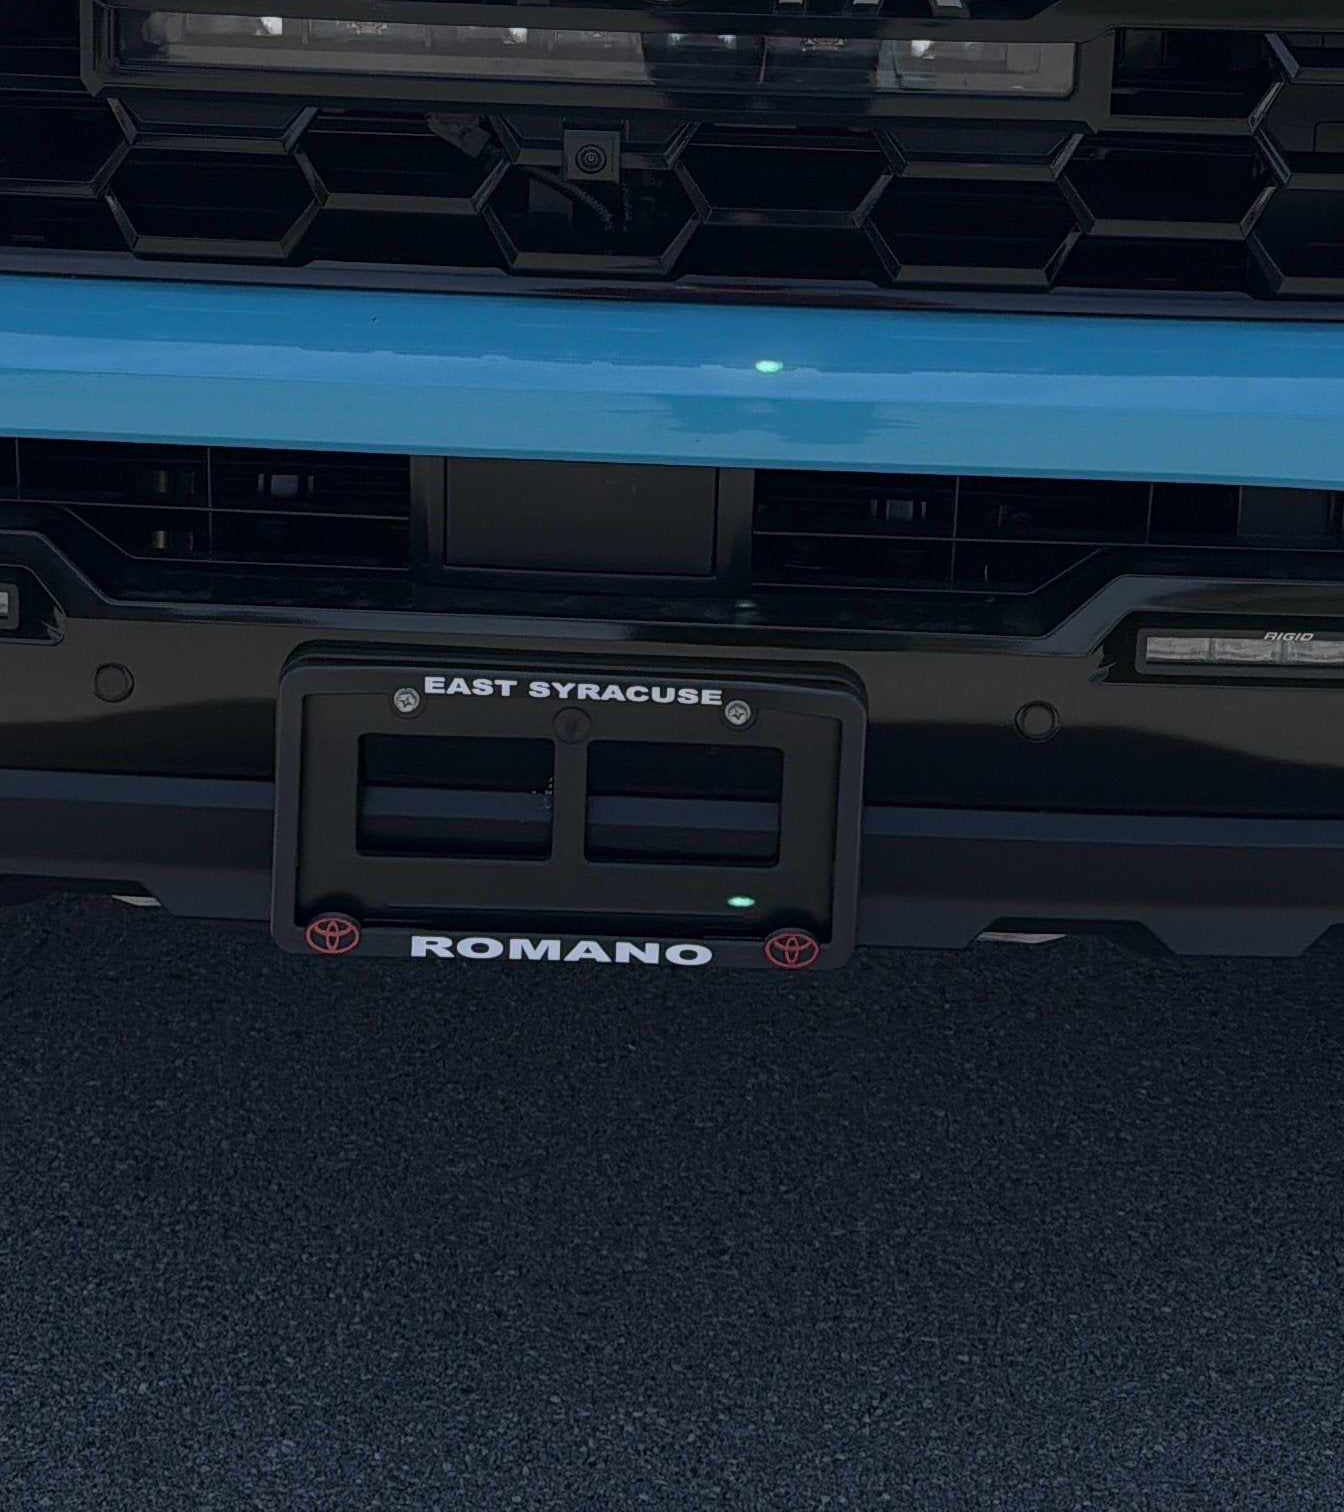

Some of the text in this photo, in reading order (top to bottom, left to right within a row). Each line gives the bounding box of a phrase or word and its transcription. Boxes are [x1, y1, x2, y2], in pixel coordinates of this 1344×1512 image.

[1263, 631, 1315, 642] RIGID
[423, 676, 723, 706] EAST SYRACUSE
[410, 935, 713, 966] ROMANO
